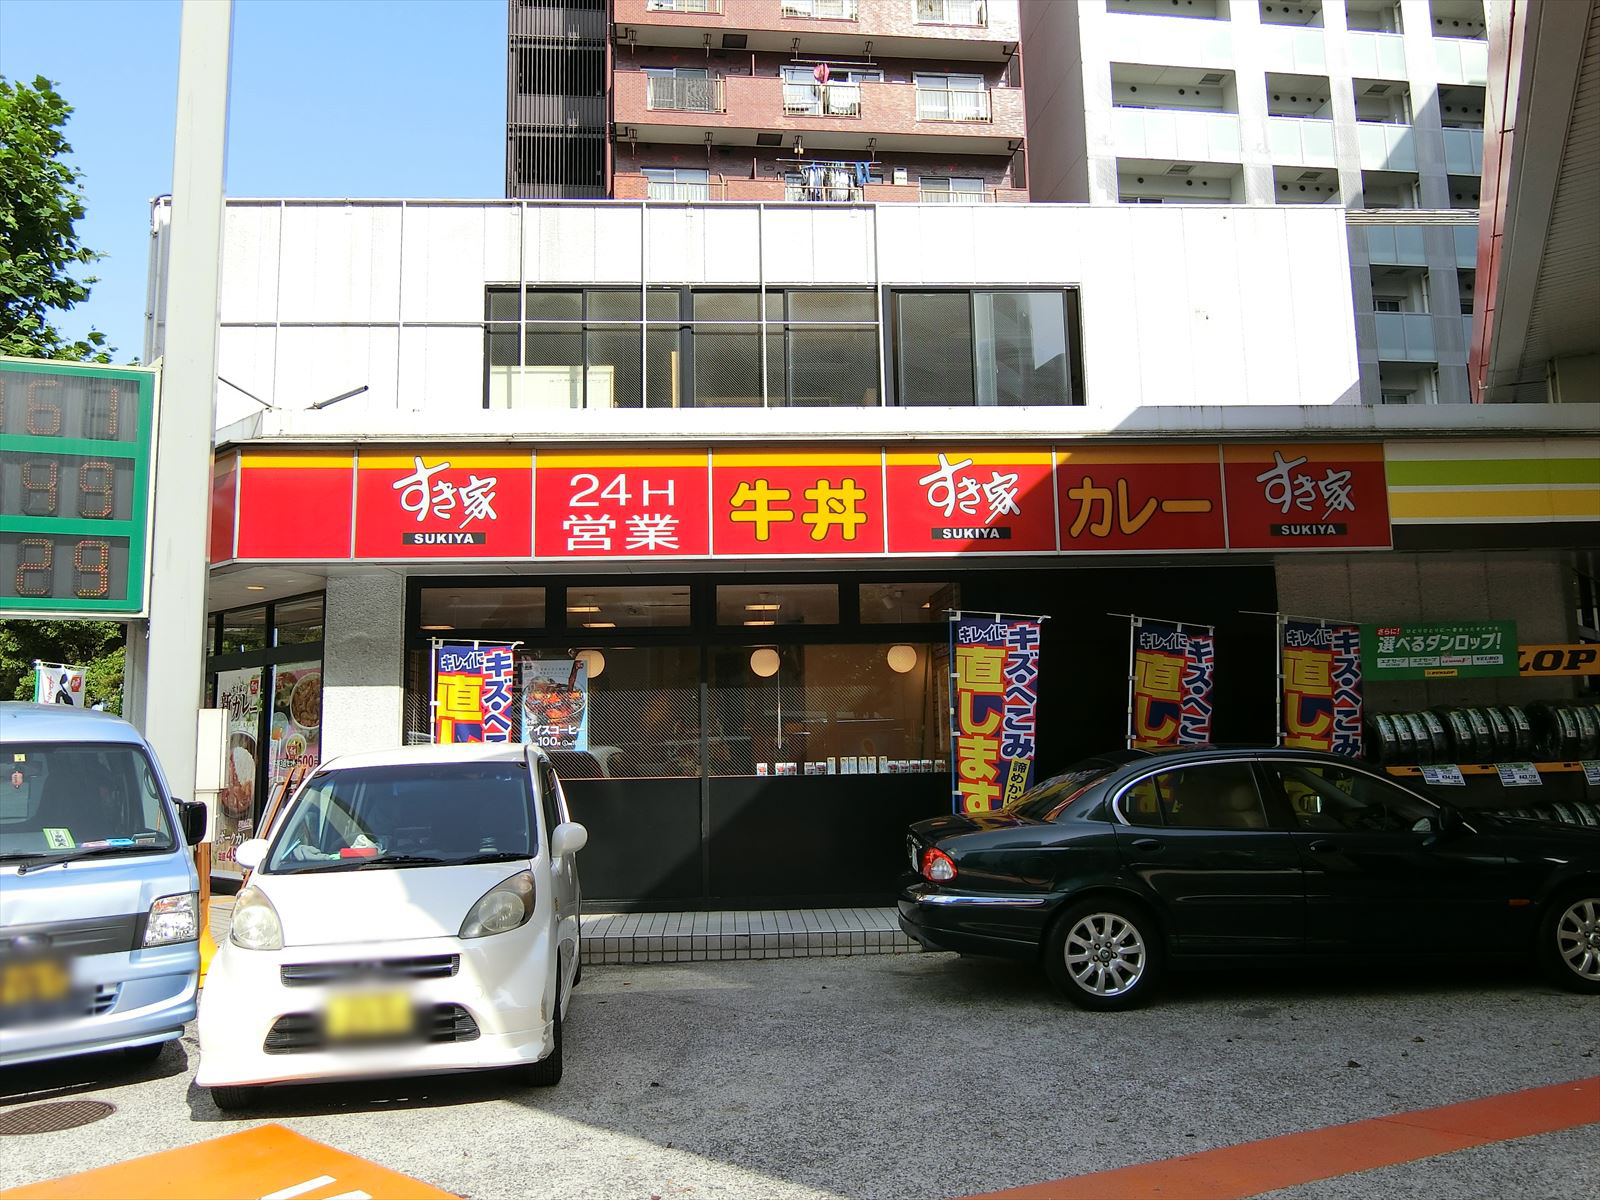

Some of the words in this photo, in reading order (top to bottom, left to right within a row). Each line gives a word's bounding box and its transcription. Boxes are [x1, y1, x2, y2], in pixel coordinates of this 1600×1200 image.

[393, 456, 498, 529] すき家
[919, 452, 1021, 525] すき家
[1256, 450, 1355, 520] すき家
[729, 478, 868, 542] 牛丼
[1067, 476, 1213, 538] カレー
[413, 532, 475, 544] SUKIYA
[561, 513, 682, 551] 営業
[941, 527, 1000, 539] SUKIYA
[1280, 524, 1337, 535] SUKIYA
[959, 623, 1007, 644] キレイに
[1139, 632, 1188, 650] キレイに
[1286, 628, 1333, 647] キレイに
[1377, 632, 1502, 654] 選べるダンロップ!
[440, 651, 485, 671] キレイに
[483, 650, 513, 743] キズ・へ
[1177, 637, 1215, 745] キズ・へこ
[525, 724, 585, 736] アイスコーヒー
[955, 645, 1006, 814] 直します
